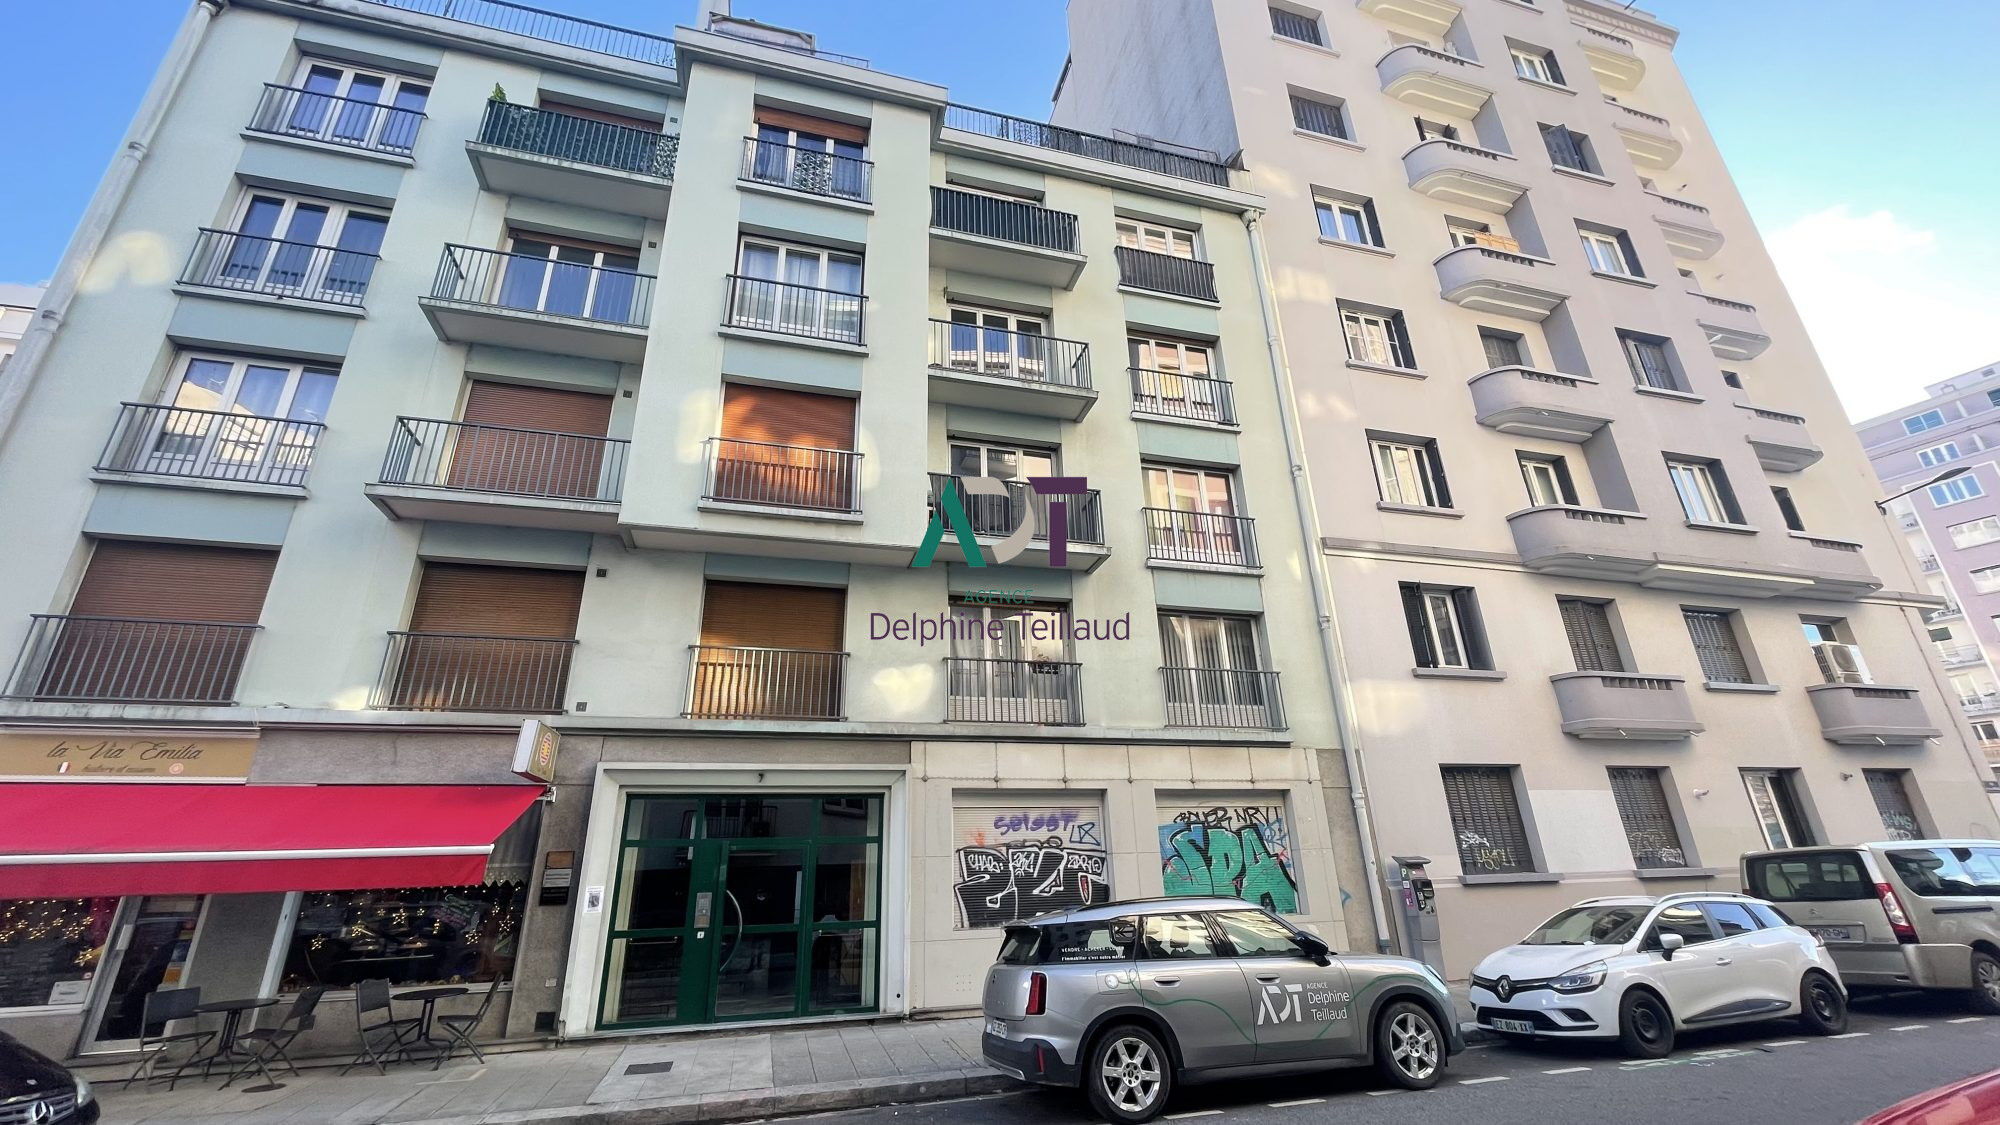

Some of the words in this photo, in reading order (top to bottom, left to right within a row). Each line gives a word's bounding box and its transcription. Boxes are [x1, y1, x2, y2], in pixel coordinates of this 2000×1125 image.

[130, 740, 205, 761] Emilia
[1306, 981, 1328, 990] AGENCE
[1257, 983, 1303, 1026] ADT
[1307, 989, 1350, 1006] Delphine
[1310, 1006, 1348, 1021] Teillaud
